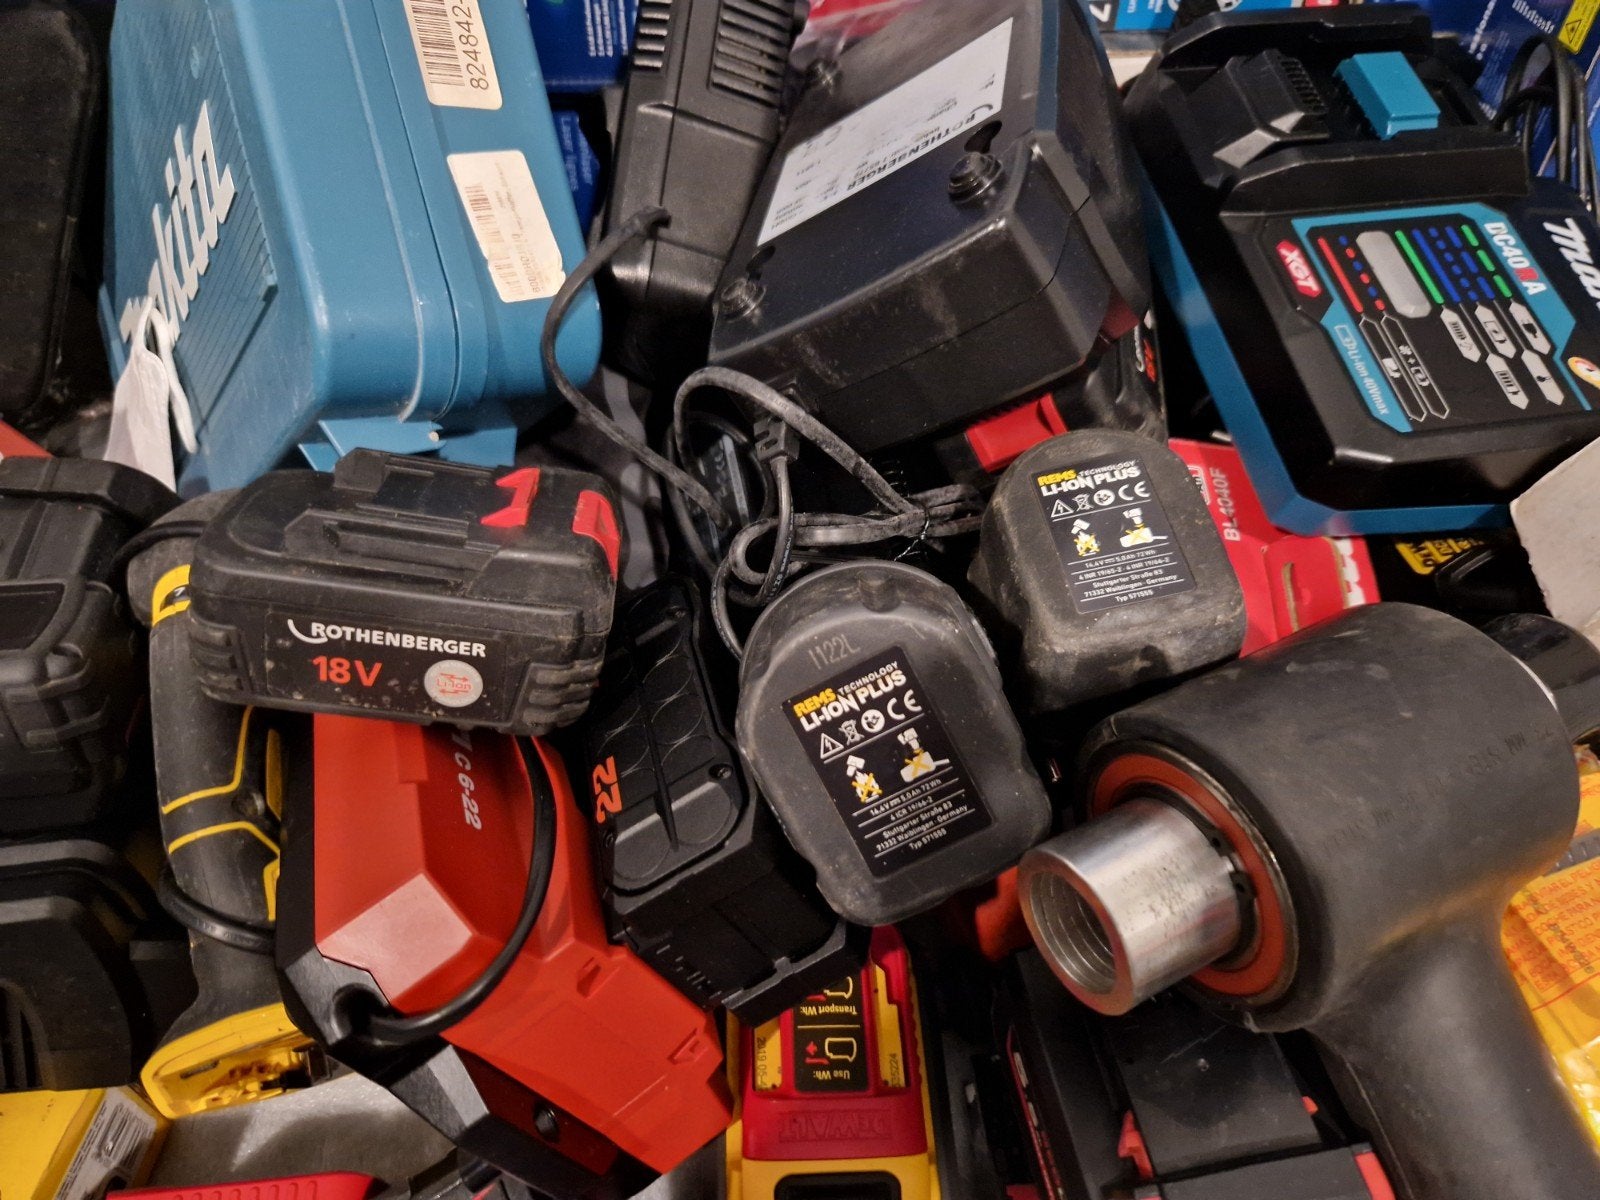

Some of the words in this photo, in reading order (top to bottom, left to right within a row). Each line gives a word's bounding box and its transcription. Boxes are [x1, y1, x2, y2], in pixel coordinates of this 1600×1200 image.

[1037, 469, 1077, 486] REMS
[1079, 460, 1136, 477] TECHNOLOGY
[1093, 466, 1141, 486] PLUS
[1084, 589, 1105, 598] 71332
[1104, 581, 1143, 594] Waiblingen
[1146, 574, 1178, 585] Germany
[1092, 576, 1130, 589] Stuttgarter
[309, 621, 487, 658] ROTHENBERGER
[793, 687, 837, 718] REMS
[838, 660, 899, 695] TECHNOLOGY
[800, 694, 861, 732] LI-ION
[855, 669, 907, 705] PLUS
[458, 772, 483, 831] 6-22
[876, 838, 897, 851] 71332
[897, 821, 934, 842] Waiblingen
[937, 804, 968, 823] Germany
[882, 818, 920, 839] Stuttgarter
[909, 840, 923, 850] Typ
[819, 1003, 858, 1016] Transport
[833, 1070, 850, 1080] Use
